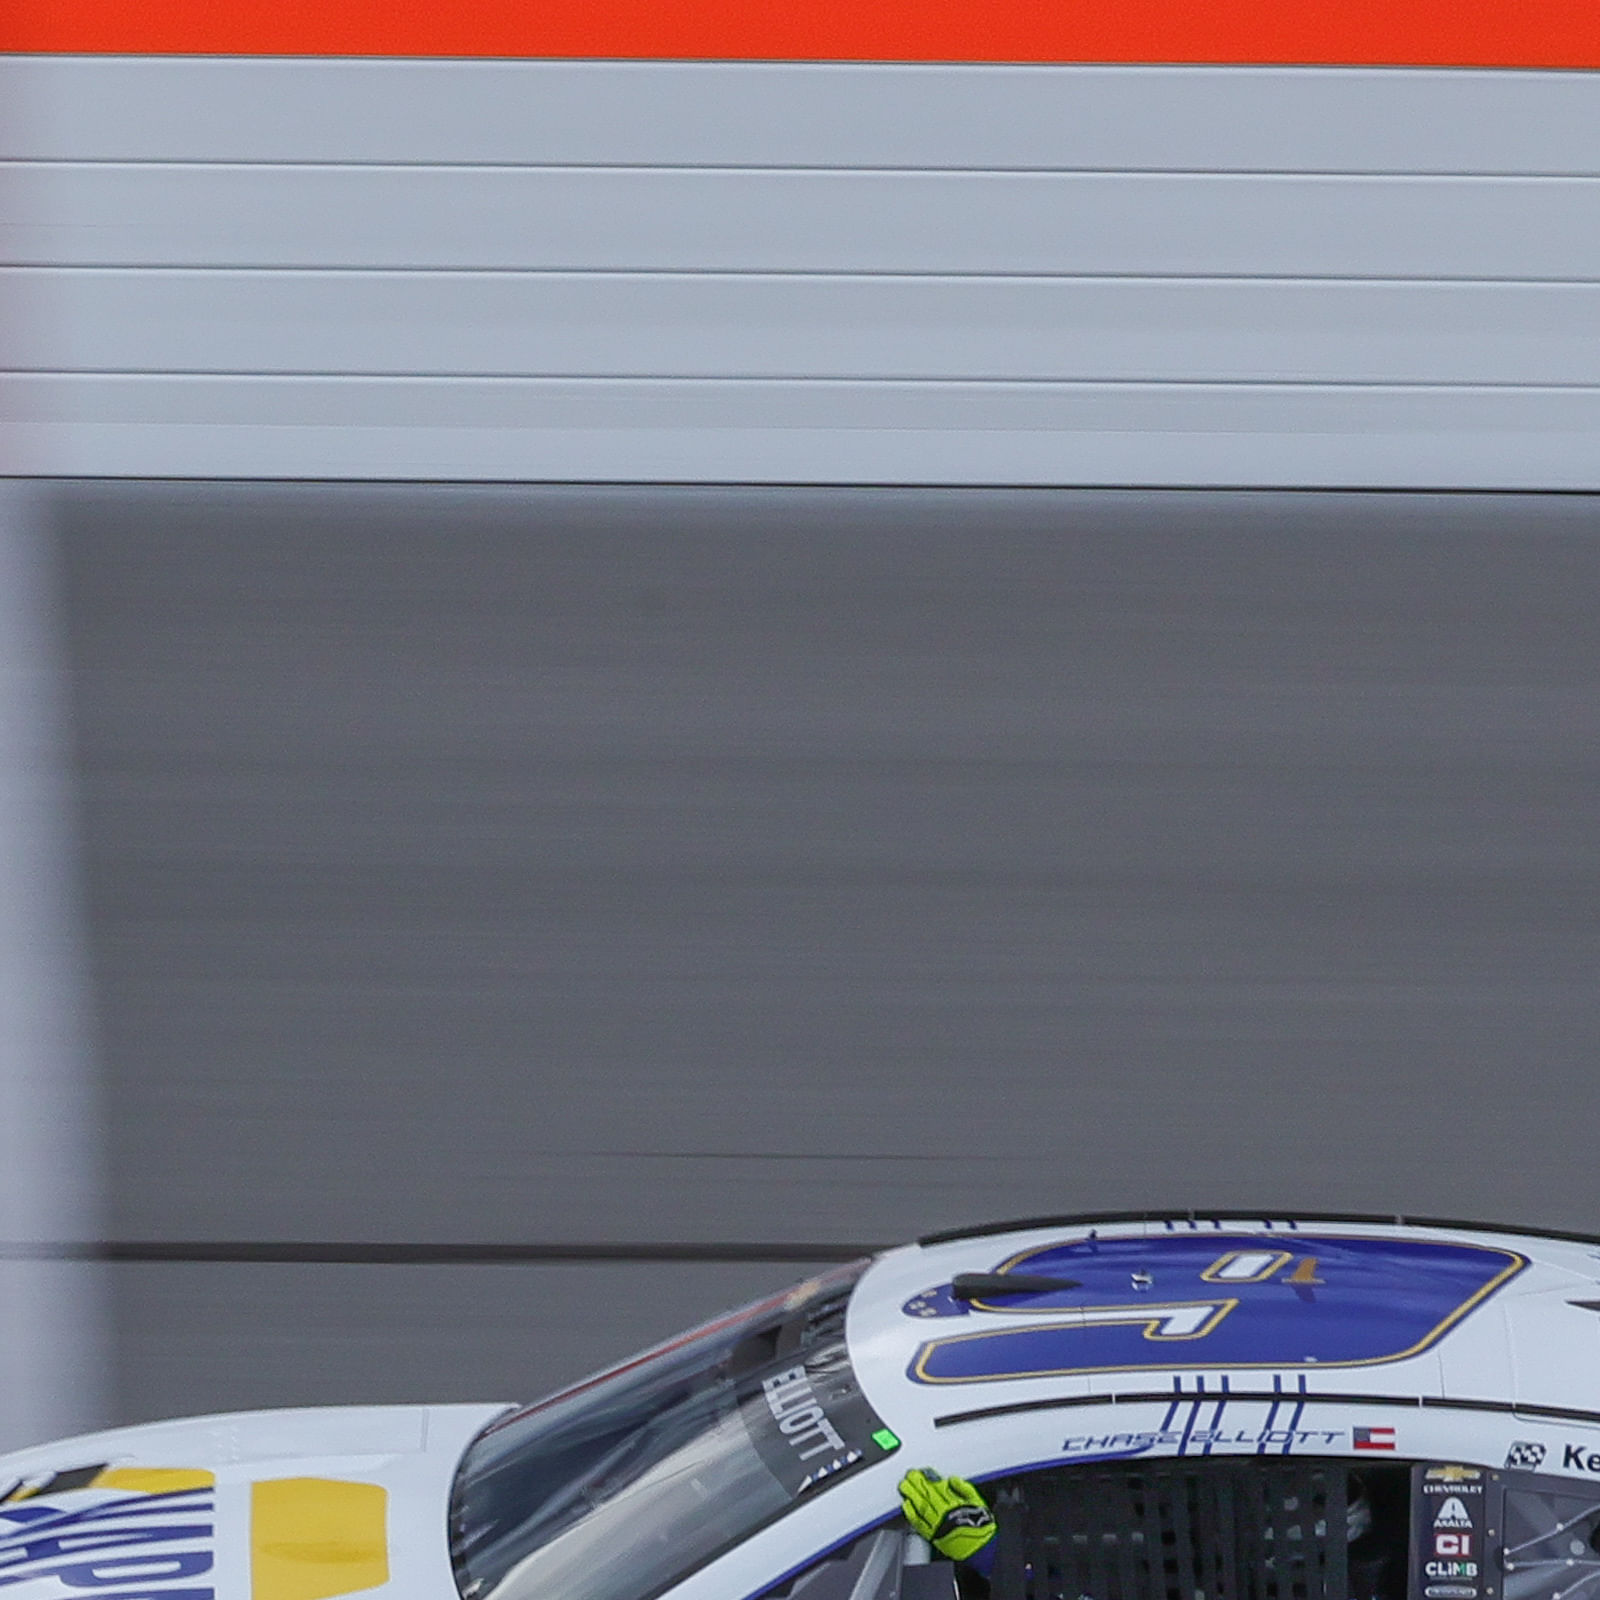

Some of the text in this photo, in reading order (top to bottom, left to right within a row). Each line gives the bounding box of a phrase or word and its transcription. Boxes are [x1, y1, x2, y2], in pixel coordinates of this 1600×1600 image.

[762, 1365, 846, 1462] ELLIOTT
[1061, 1429, 1347, 1451] CHASE ELLIOTT
